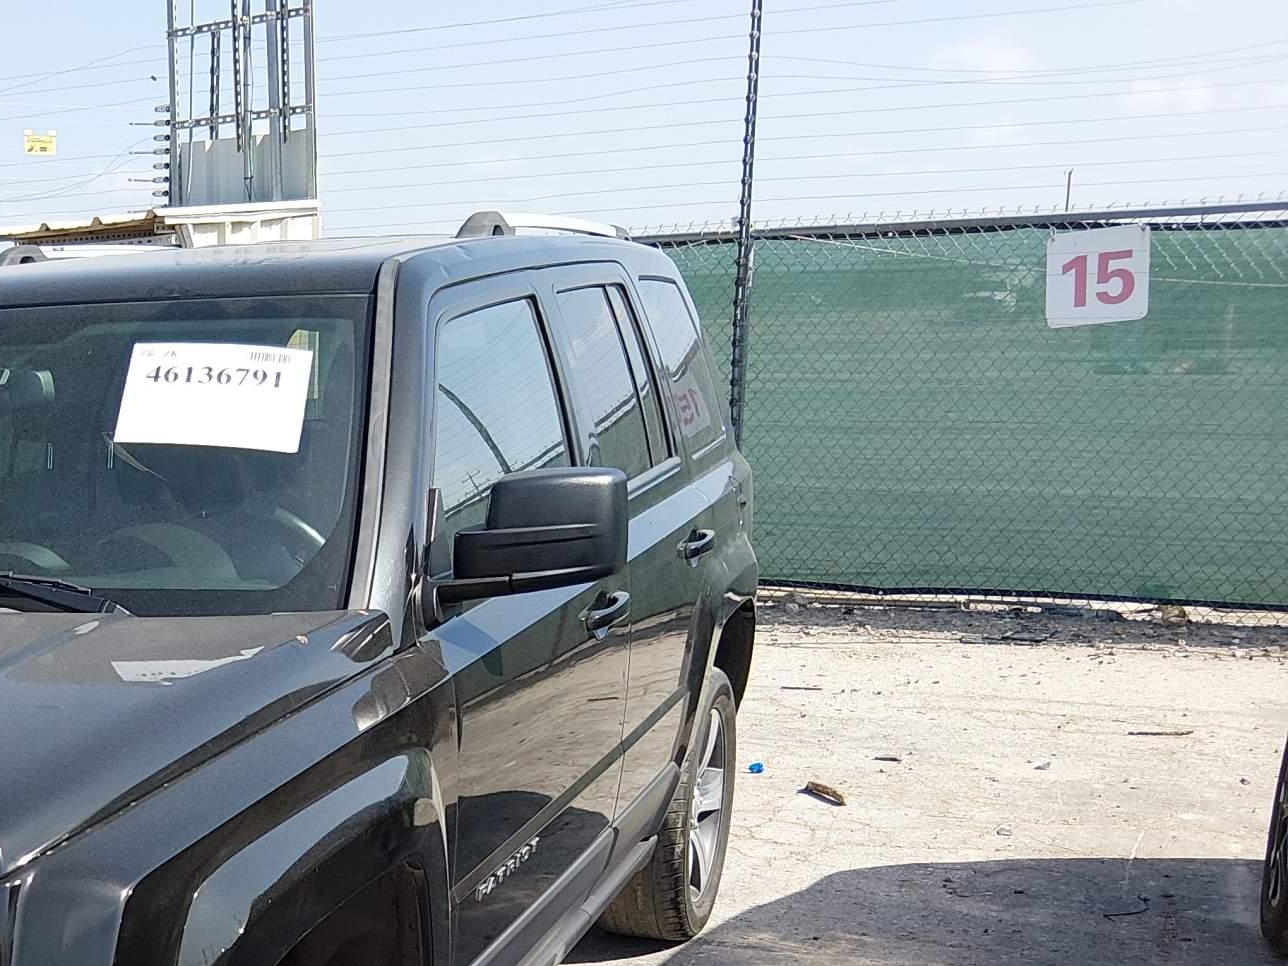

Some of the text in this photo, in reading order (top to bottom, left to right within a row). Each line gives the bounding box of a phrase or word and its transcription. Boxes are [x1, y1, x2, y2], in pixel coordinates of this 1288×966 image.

[1062, 249, 1135, 308] 15
[146, 365, 281, 388] 46136791
[476, 836, 540, 902] PATRIOT
